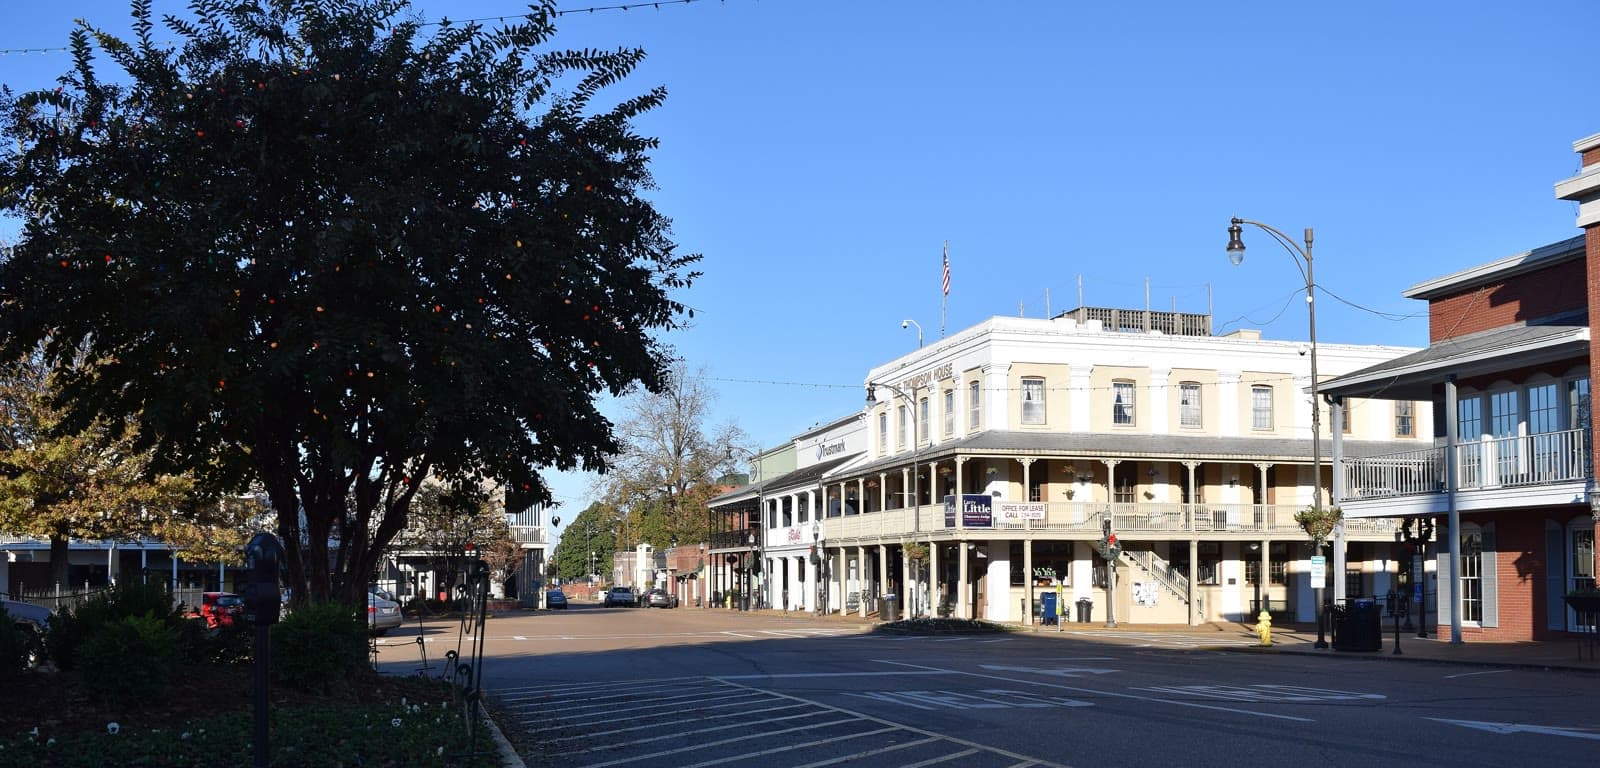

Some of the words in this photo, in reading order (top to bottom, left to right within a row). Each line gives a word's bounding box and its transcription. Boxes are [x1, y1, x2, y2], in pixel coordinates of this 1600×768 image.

[903, 371, 932, 391] THOMPSON
[933, 363, 953, 380] HOUSE
[822, 439, 846, 457] Trustmark
[964, 504, 991, 513] Little
[840, 689, 1096, 711] YIELD
